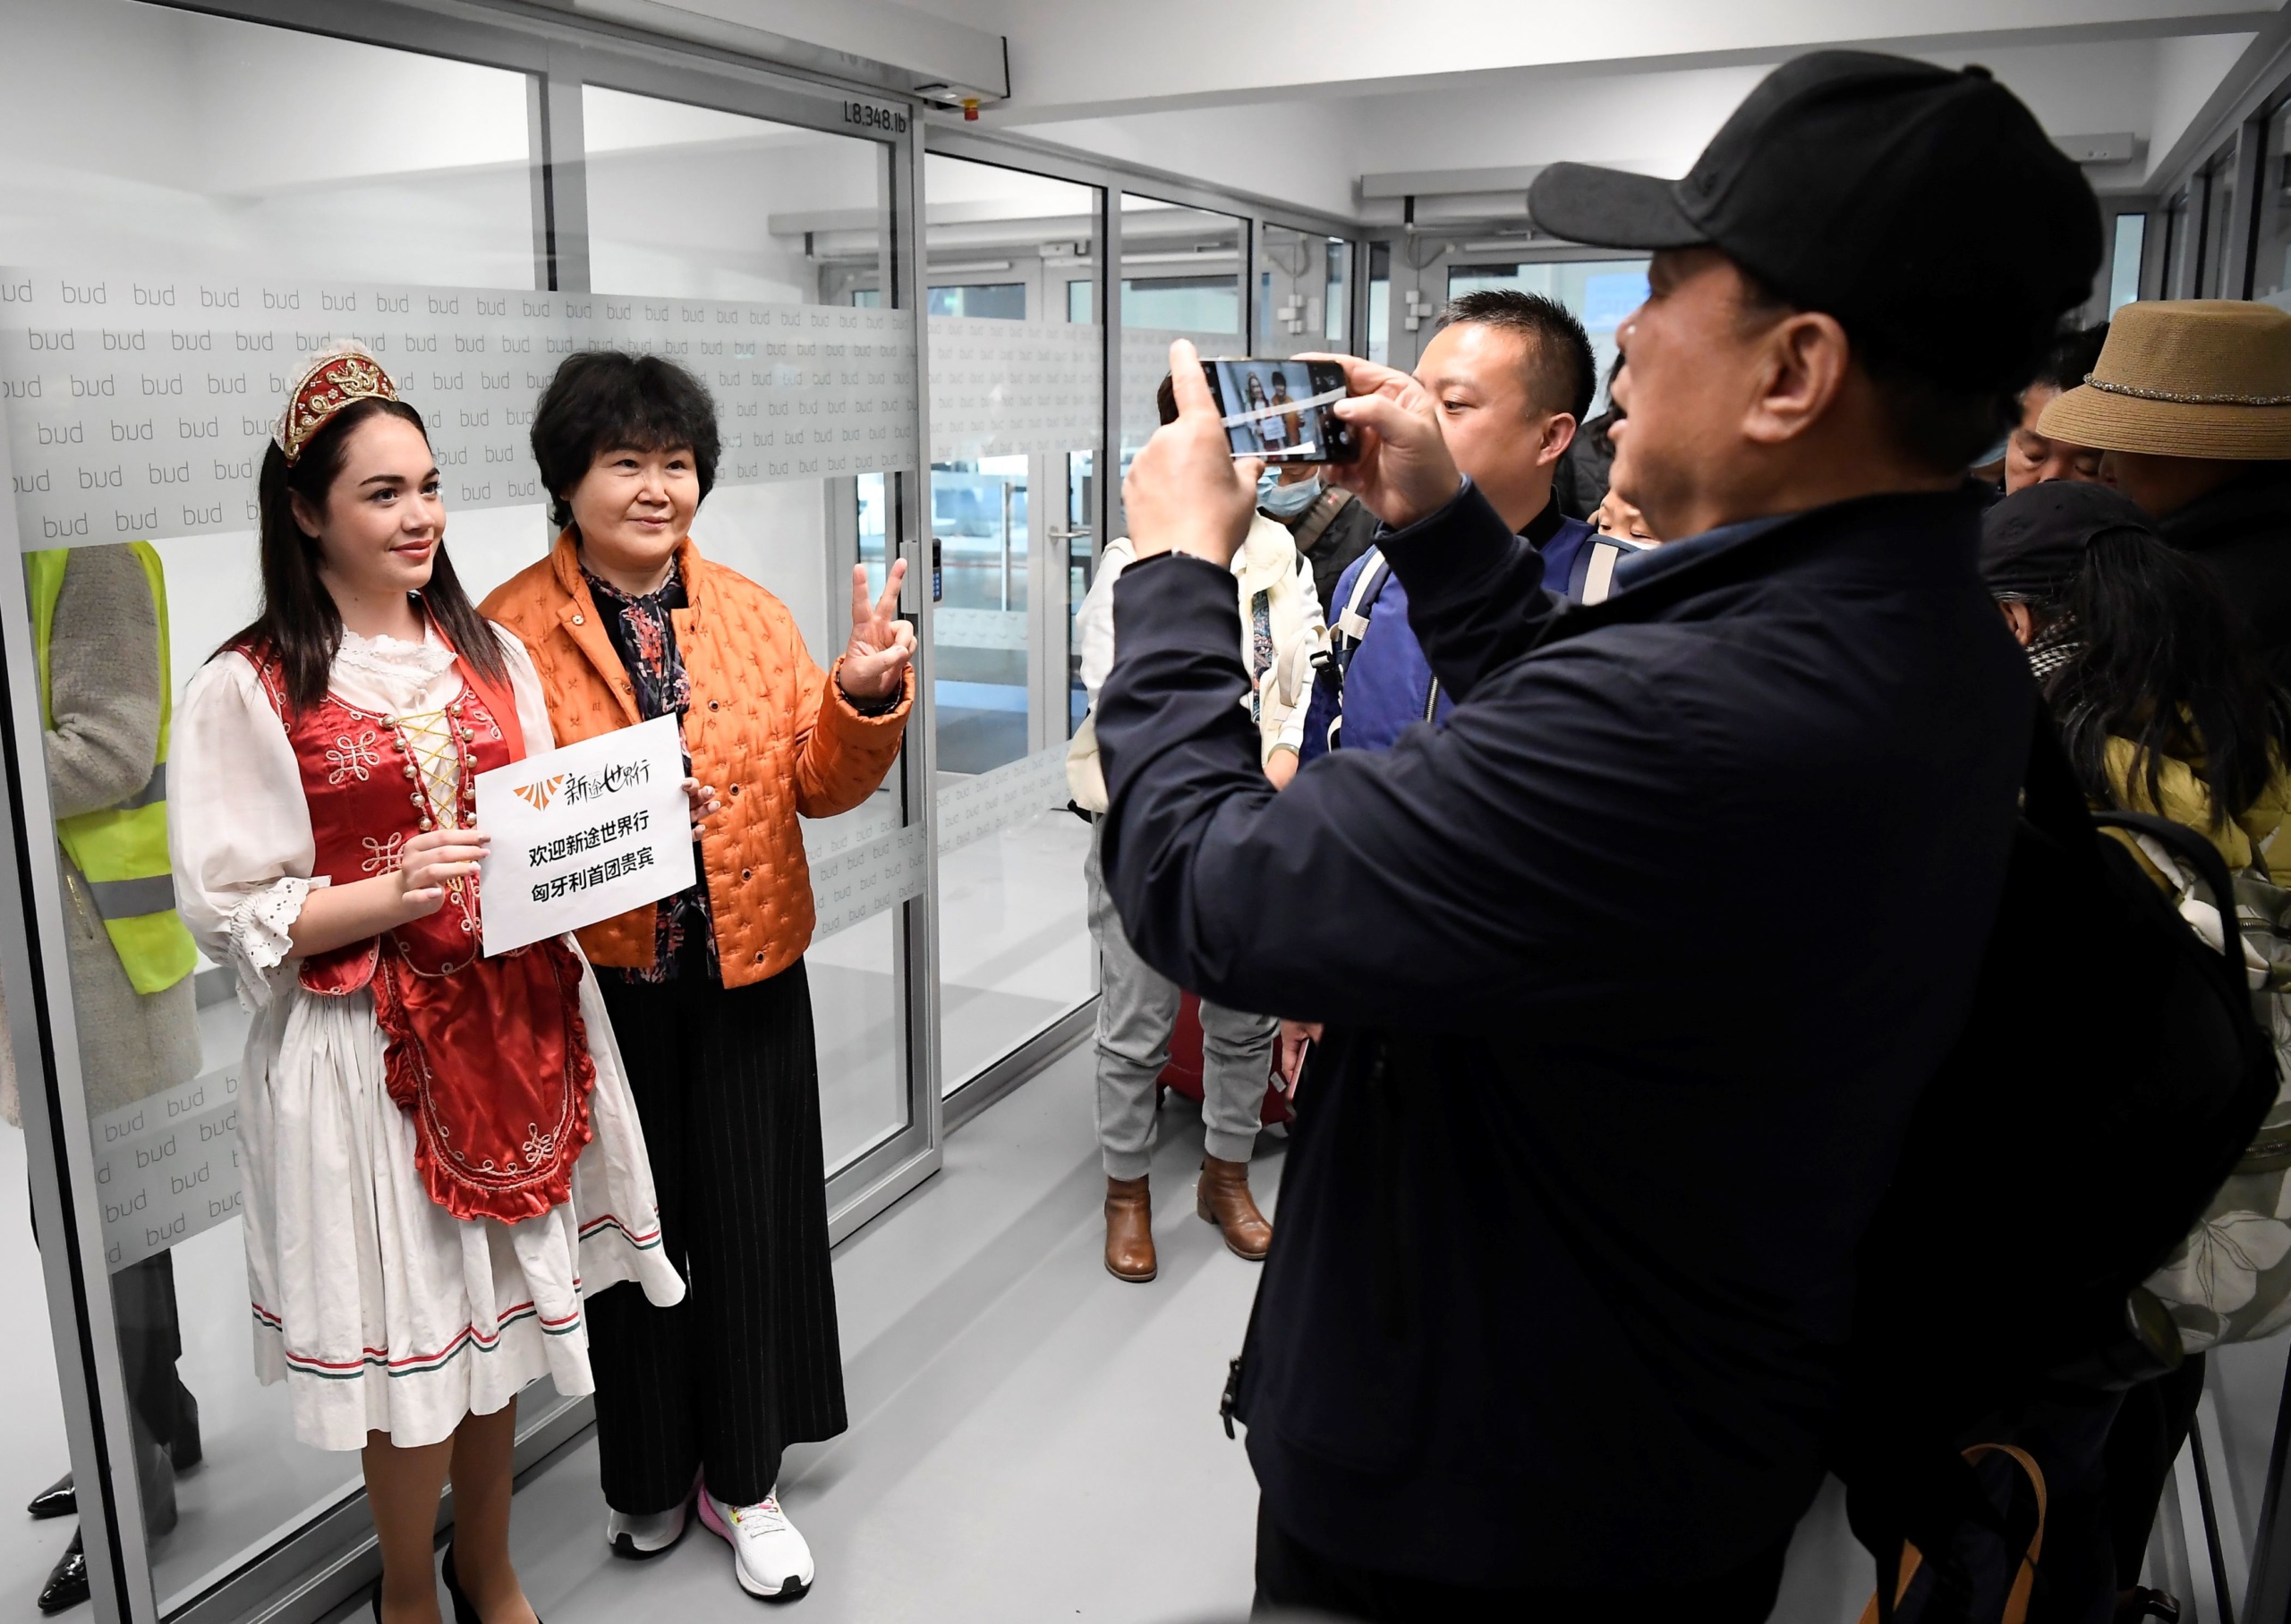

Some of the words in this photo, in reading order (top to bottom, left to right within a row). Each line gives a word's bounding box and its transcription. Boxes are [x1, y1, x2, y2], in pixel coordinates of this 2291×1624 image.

[1, 279, 32, 302] ud
[62, 281, 106, 304] bud
[133, 283, 175, 306] bud
[200, 286, 240, 308] bud
[263, 288, 299, 310] bud
[322, 290, 356, 311] bud
[377, 293, 408, 313] bud
[428, 295, 458, 314] bud
[477, 297, 506, 316] bud
[523, 299, 549, 318] bud
[566, 301, 592, 319] bud
[607, 302, 631, 320] bud
[645, 304, 669, 321] bud
[682, 306, 704, 322] bud
[717, 309, 737, 324] bud
[750, 310, 770, 325] bud
[29, 327, 74, 351] bud
[102, 327, 145, 351] bud
[172, 329, 211, 351] bud
[235, 330, 273, 351] bud
[405, 333, 437, 352] bud
[456, 334, 484, 353] bud
[502, 335, 530, 353] bud
[546, 336, 573, 353] bud
[628, 338, 652, 354] bud
[665, 339, 688, 354] bud
[702, 339, 722, 354] bud
[735, 340, 755, 355] bud
[71, 374, 115, 397] bud
[141, 373, 183, 395] bud
[208, 372, 246, 394] bud
[394, 372, 413, 391] ud
[433, 372, 463, 390] bud
[481, 371, 509, 389] bud
[720, 370, 740, 387] bud
[752, 370, 771, 386] bud
[38, 421, 83, 445] bud
[111, 418, 153, 442] bud
[179, 416, 218, 438] bud
[460, 408, 489, 427] bud
[737, 401, 757, 417] bud
[79, 465, 122, 489] bud
[149, 461, 190, 484] bud
[214, 458, 252, 480] bud
[485, 444, 513, 463] bud
[721, 432, 742, 447] bud
[754, 431, 773, 446] bud
[43, 512, 88, 538] bud
[115, 506, 158, 531] bud
[183, 502, 222, 525] bud
[462, 481, 490, 501] bud
[508, 479, 535, 497] bud
[737, 462, 757, 478] bud
[564, 759, 651, 806] 新途世界行
[528, 810, 650, 868] 欢迎新途世界行
[531, 846, 654, 903] 匈牙利首团贵宾
[105, 1110, 144, 1142] bud
[167, 1086, 204, 1118] bud
[136, 1135, 176, 1169] bud
[106, 1188, 147, 1223] bud
[171, 1161, 209, 1195] bud
[146, 1212, 185, 1246] bud
